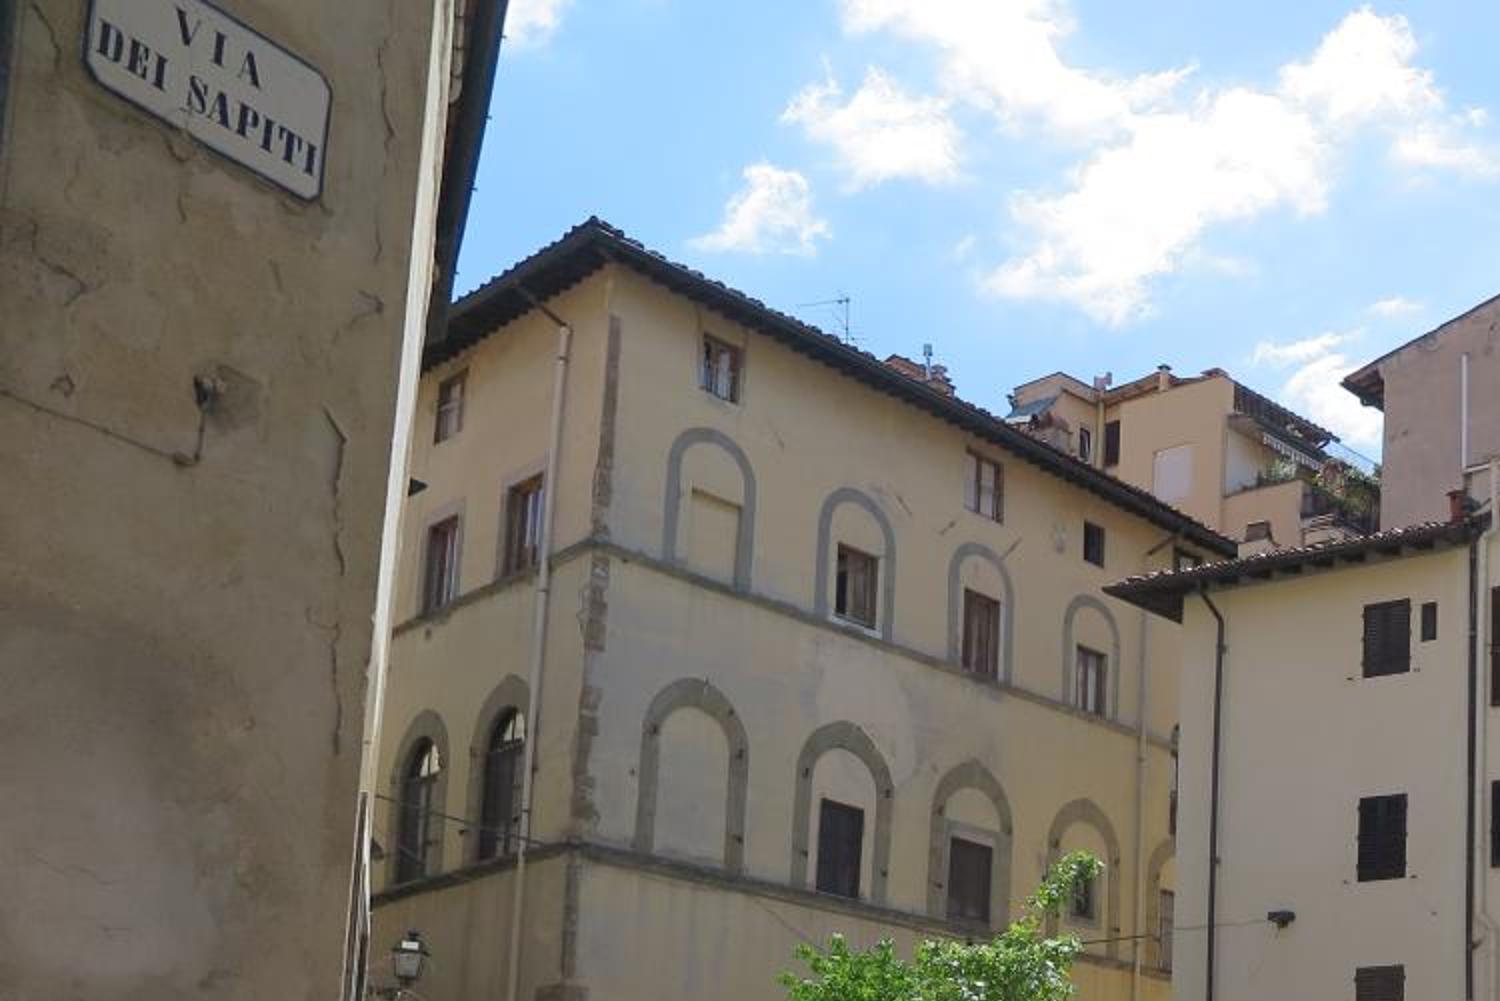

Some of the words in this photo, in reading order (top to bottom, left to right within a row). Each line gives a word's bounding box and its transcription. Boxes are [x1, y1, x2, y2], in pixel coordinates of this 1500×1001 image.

[96, 20, 168, 91] DEI
[185, 74, 318, 176] SAPITI
[175, 6, 261, 89] VIA
